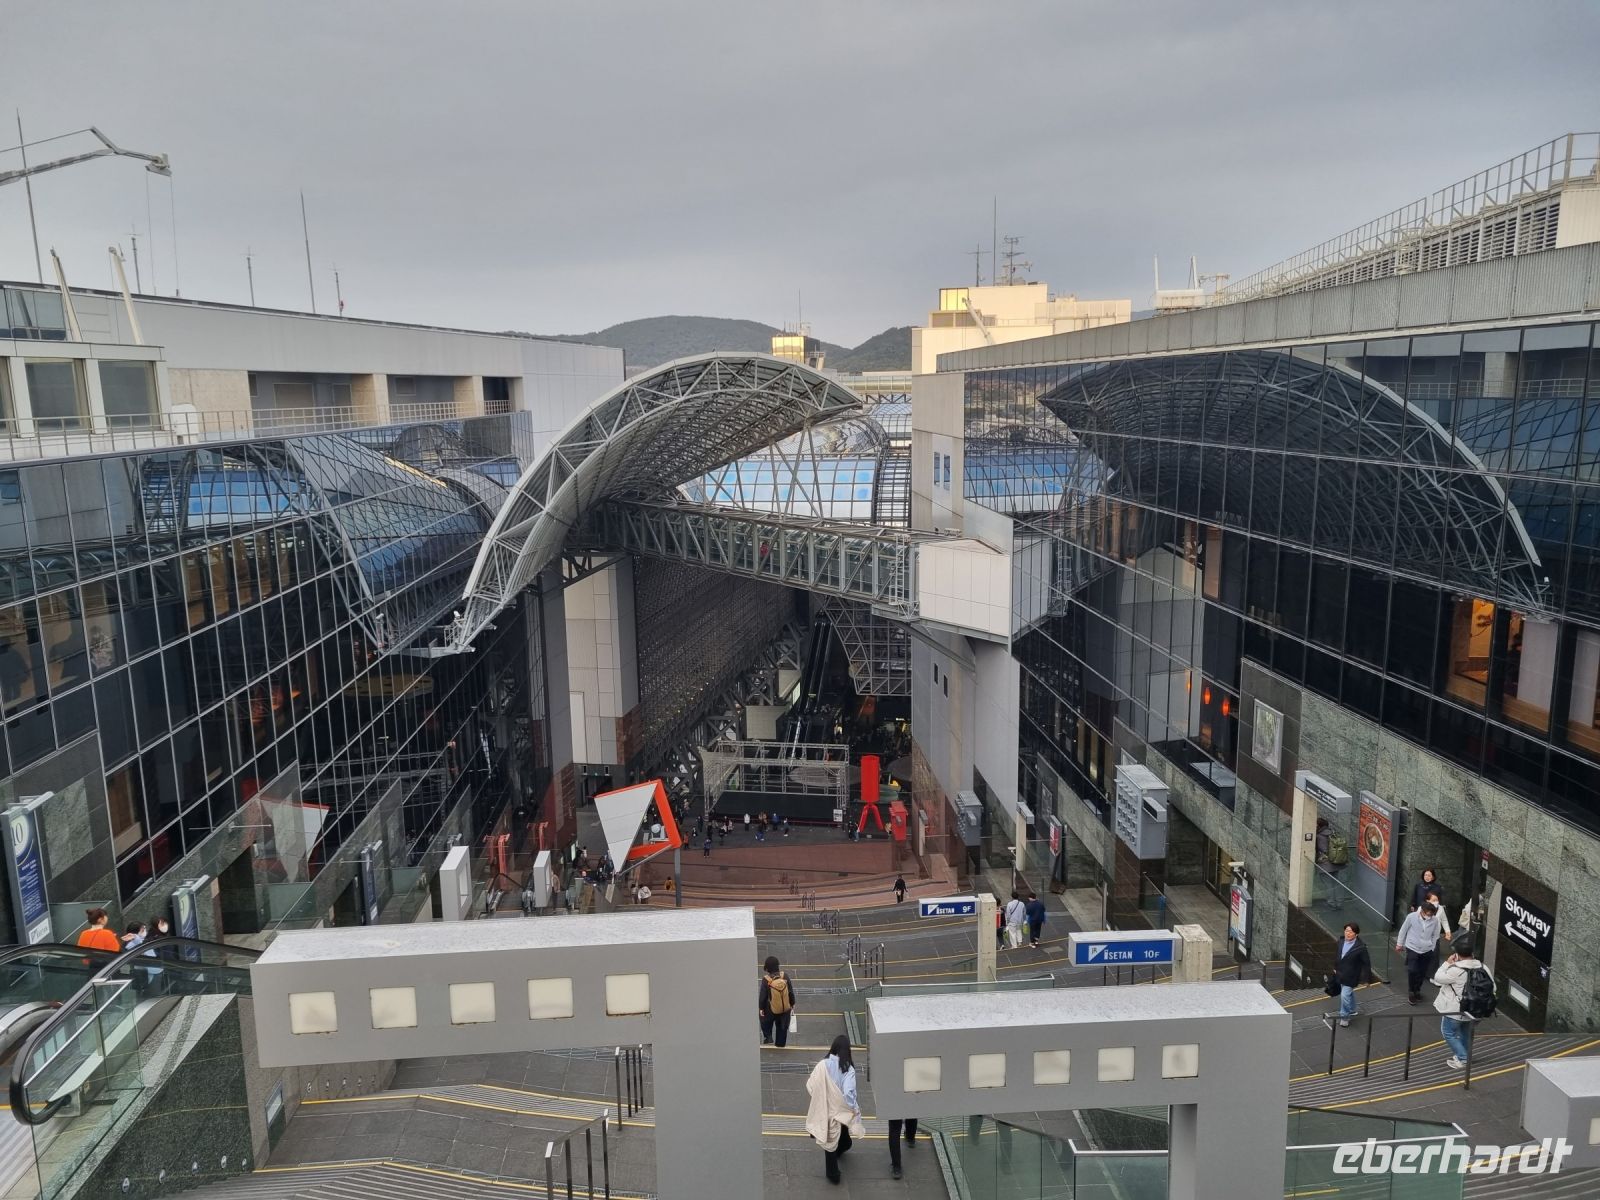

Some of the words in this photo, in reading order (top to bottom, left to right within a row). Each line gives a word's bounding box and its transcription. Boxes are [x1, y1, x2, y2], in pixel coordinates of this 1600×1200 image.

[962, 905, 972, 913] 9F
[1505, 895, 1551, 938] Skyway
[1104, 949, 1133, 960] ISETAN
[1144, 950, 1160, 959] 10F
